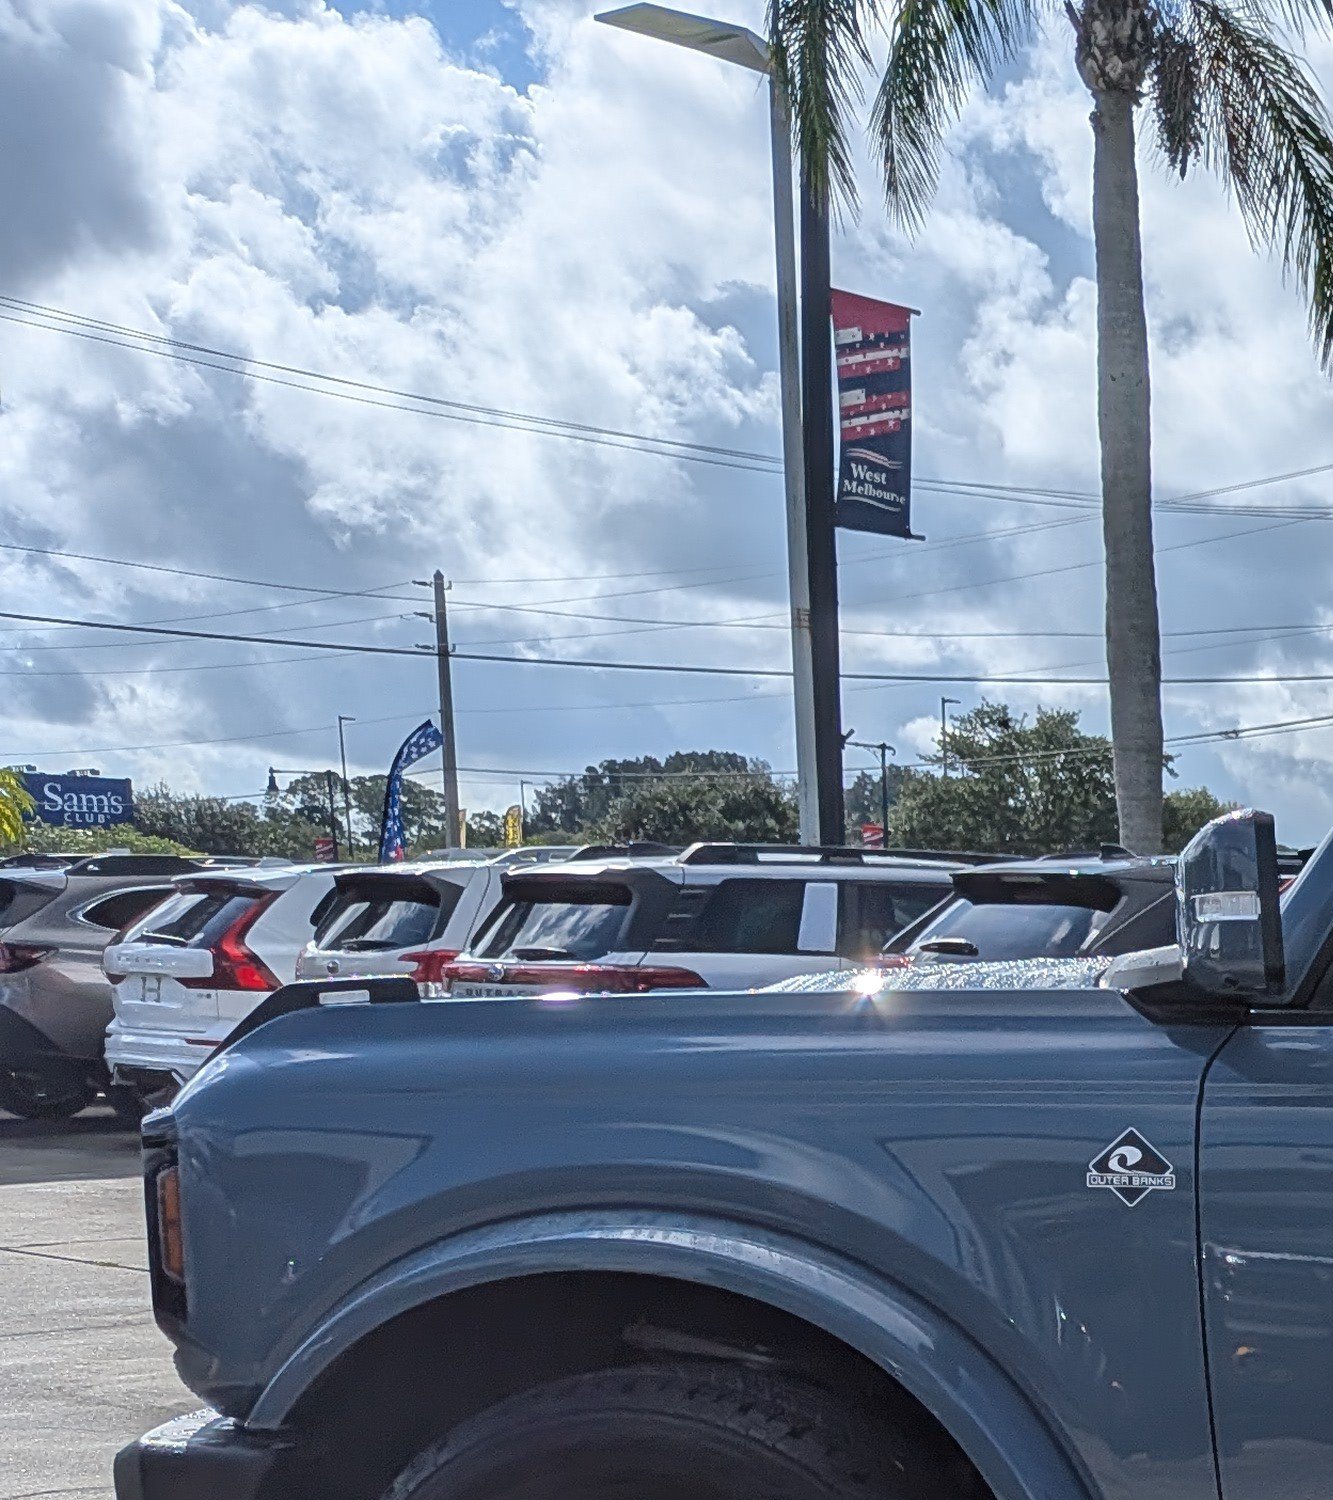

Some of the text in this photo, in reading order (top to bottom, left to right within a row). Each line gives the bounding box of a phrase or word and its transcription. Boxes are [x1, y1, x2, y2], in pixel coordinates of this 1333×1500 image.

[849, 462, 887, 485] West
[842, 479, 906, 505] Melbourne
[43, 782, 123, 815] Sam's
[64, 812, 106, 824] CLUB
[1090, 1175, 1172, 1187] OUTER BANKS
